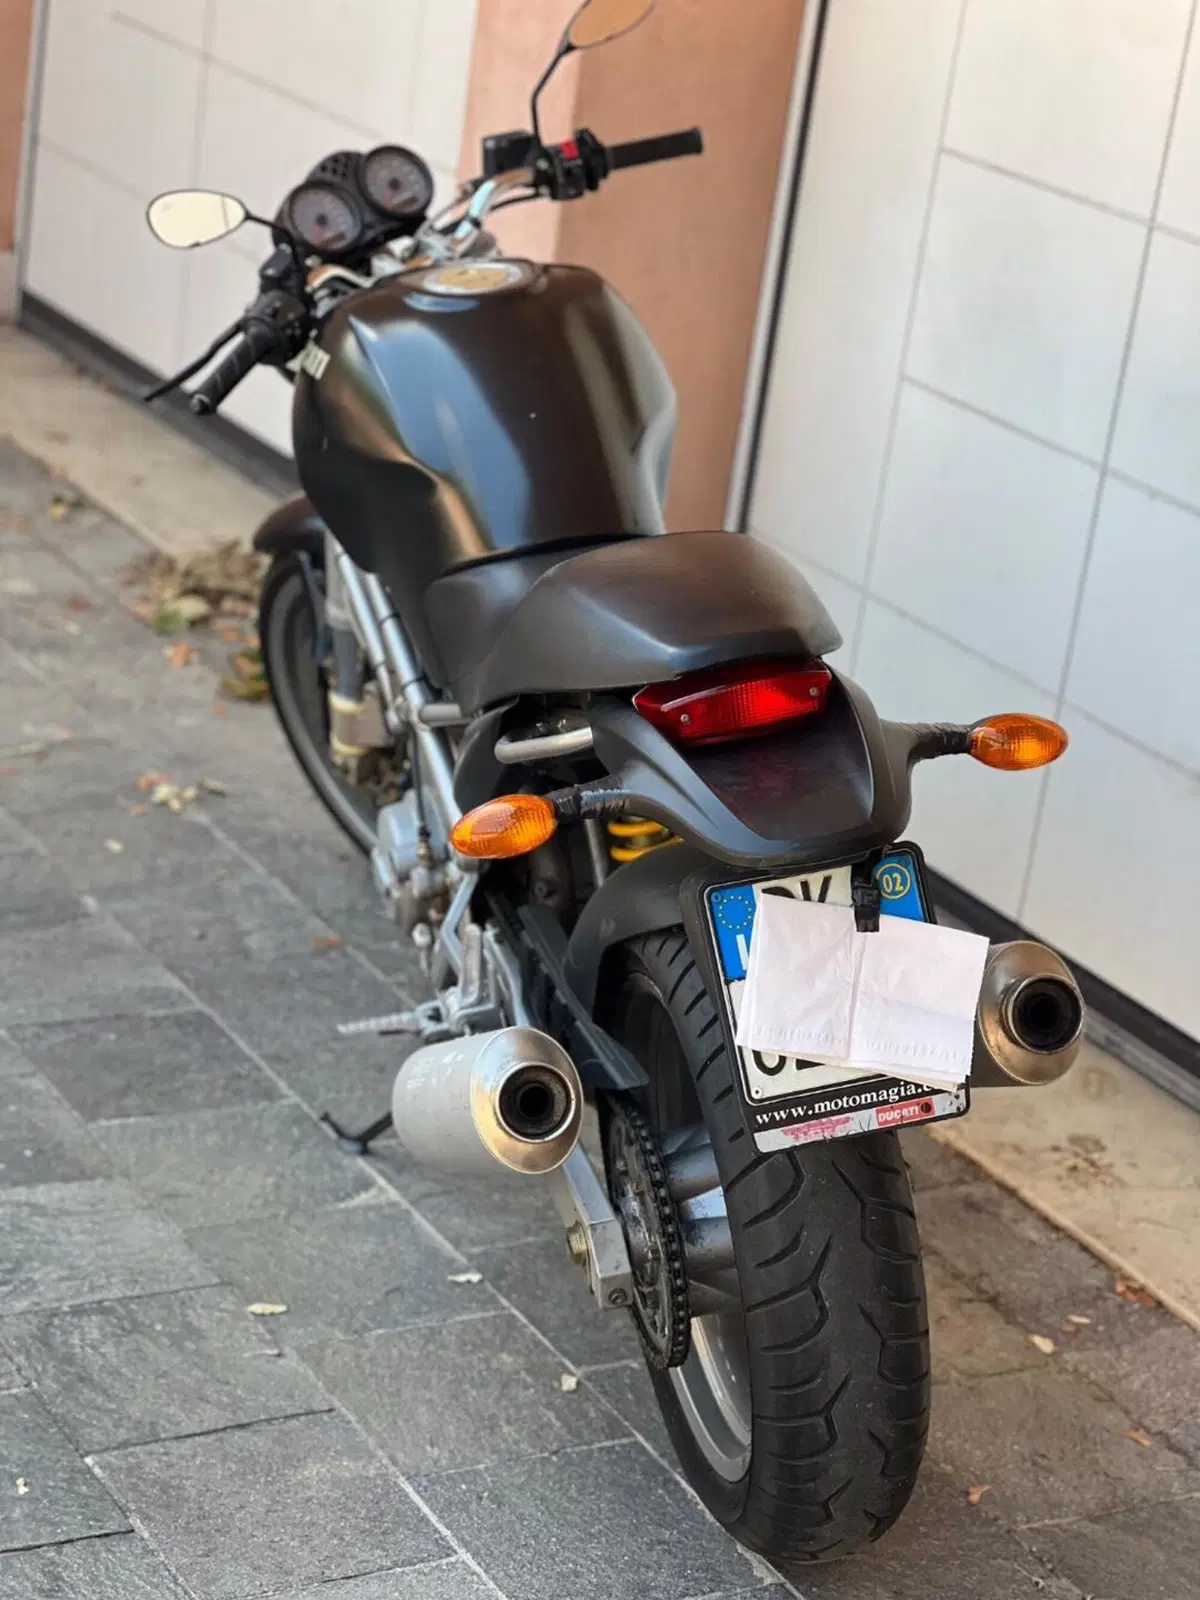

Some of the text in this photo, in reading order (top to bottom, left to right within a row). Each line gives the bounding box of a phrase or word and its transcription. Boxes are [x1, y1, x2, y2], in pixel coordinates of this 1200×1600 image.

[882, 873, 904, 892] 02
[755, 1081, 934, 1125] www.motomagia.c
[877, 1104, 920, 1123] DUCATI
